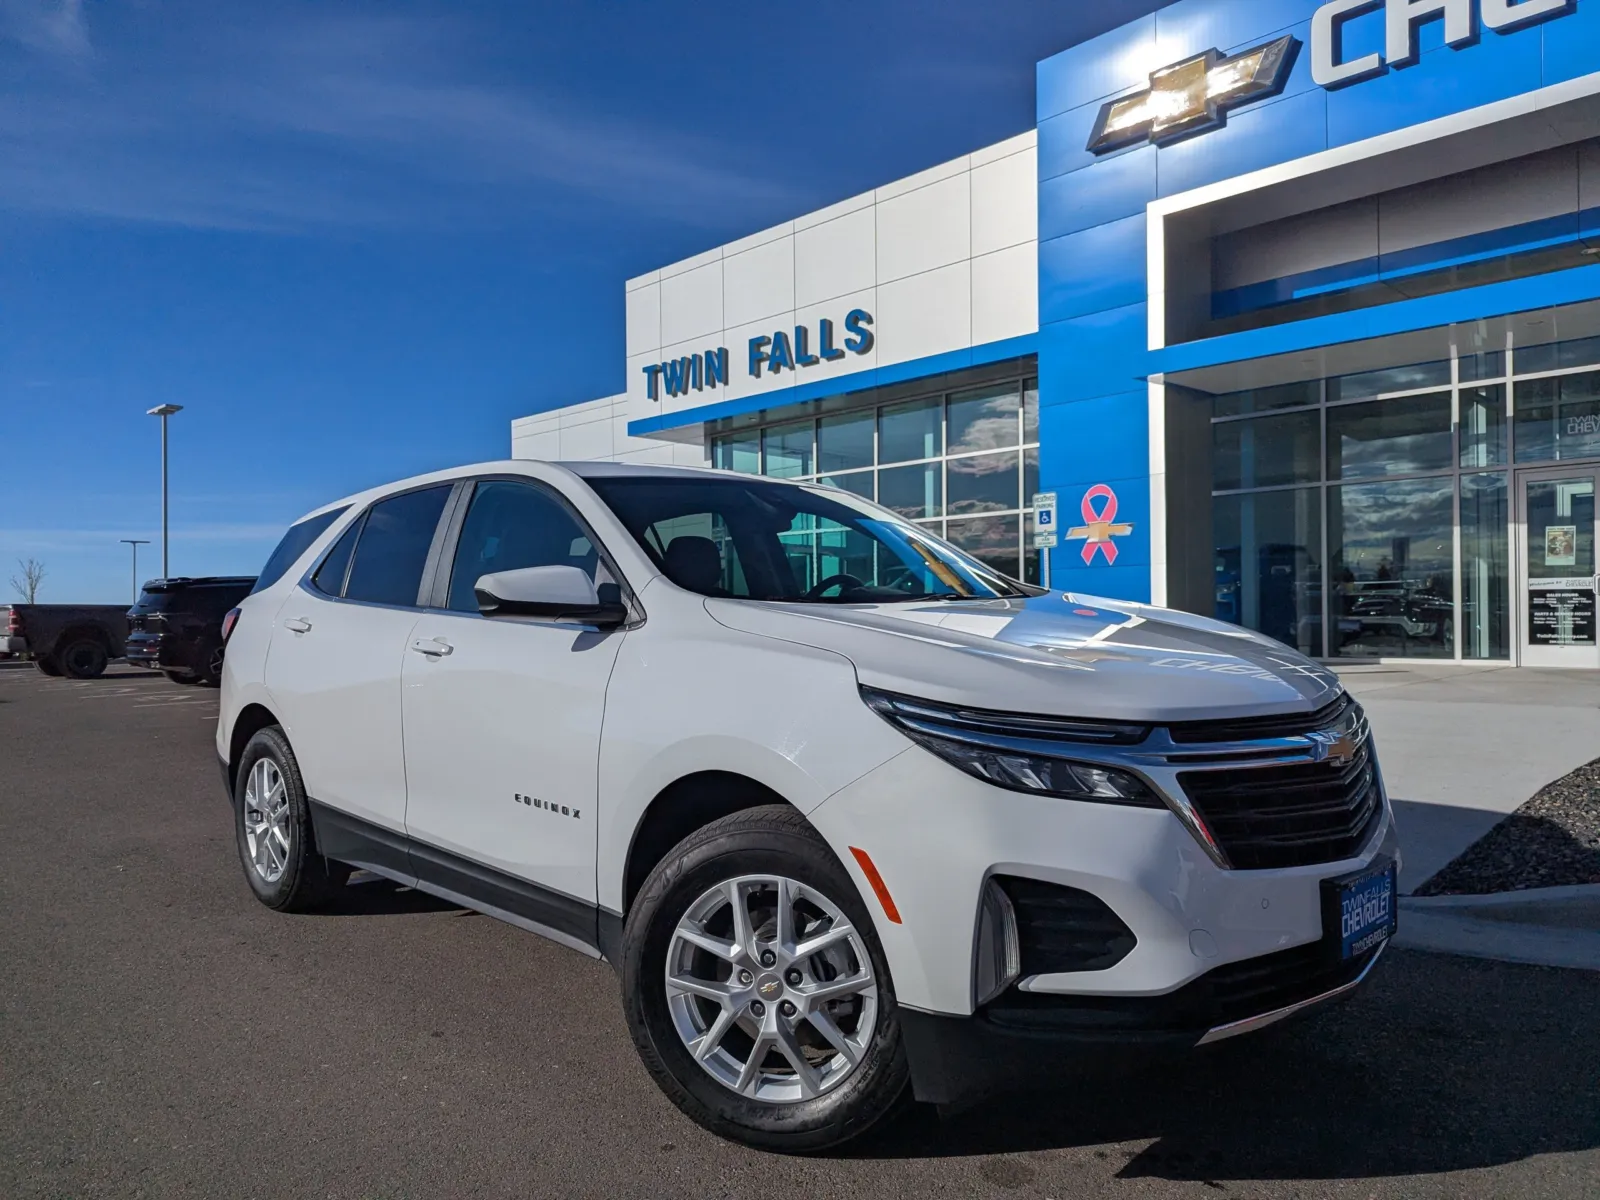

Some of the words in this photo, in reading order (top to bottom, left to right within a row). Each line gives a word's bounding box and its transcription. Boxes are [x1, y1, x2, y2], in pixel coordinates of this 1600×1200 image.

[642, 347, 728, 402] TWIN
[748, 308, 875, 379] FALLS
[514, 793, 581, 819] EQUINOX
[1342, 892, 1390, 938] CHEVROLET
